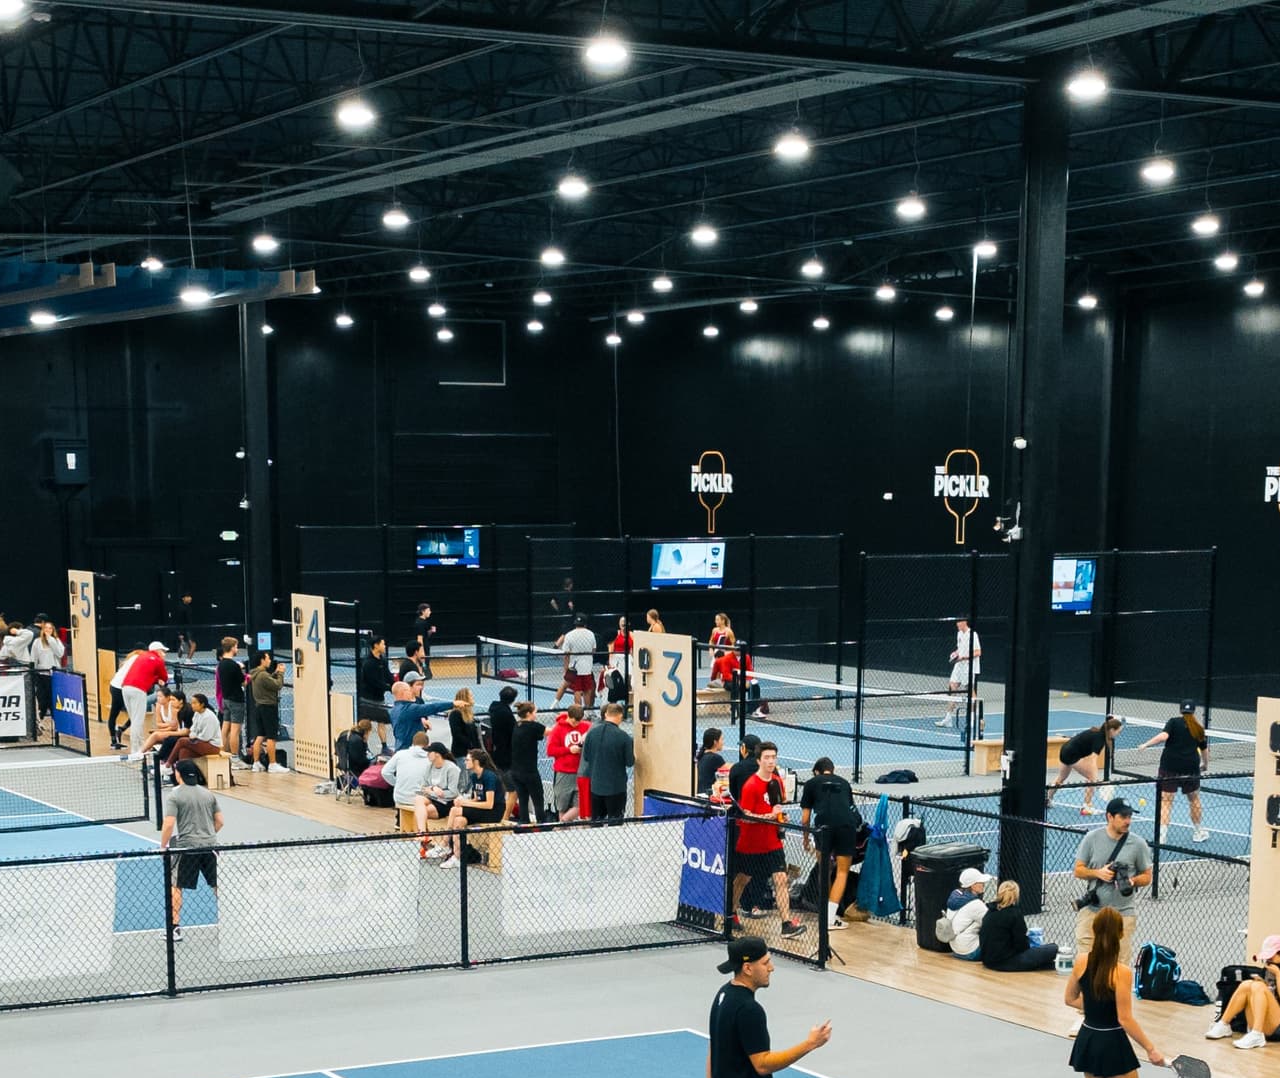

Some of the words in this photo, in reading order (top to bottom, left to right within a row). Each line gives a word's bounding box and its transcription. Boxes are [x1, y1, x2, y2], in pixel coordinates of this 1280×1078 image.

[691, 472, 734, 493] PICKLR
[934, 474, 990, 498] PICKLR
[80, 582, 91, 618] 5
[307, 609, 321, 652] 4
[661, 651, 683, 707] 3
[63, 701, 84, 716] JOOLA
